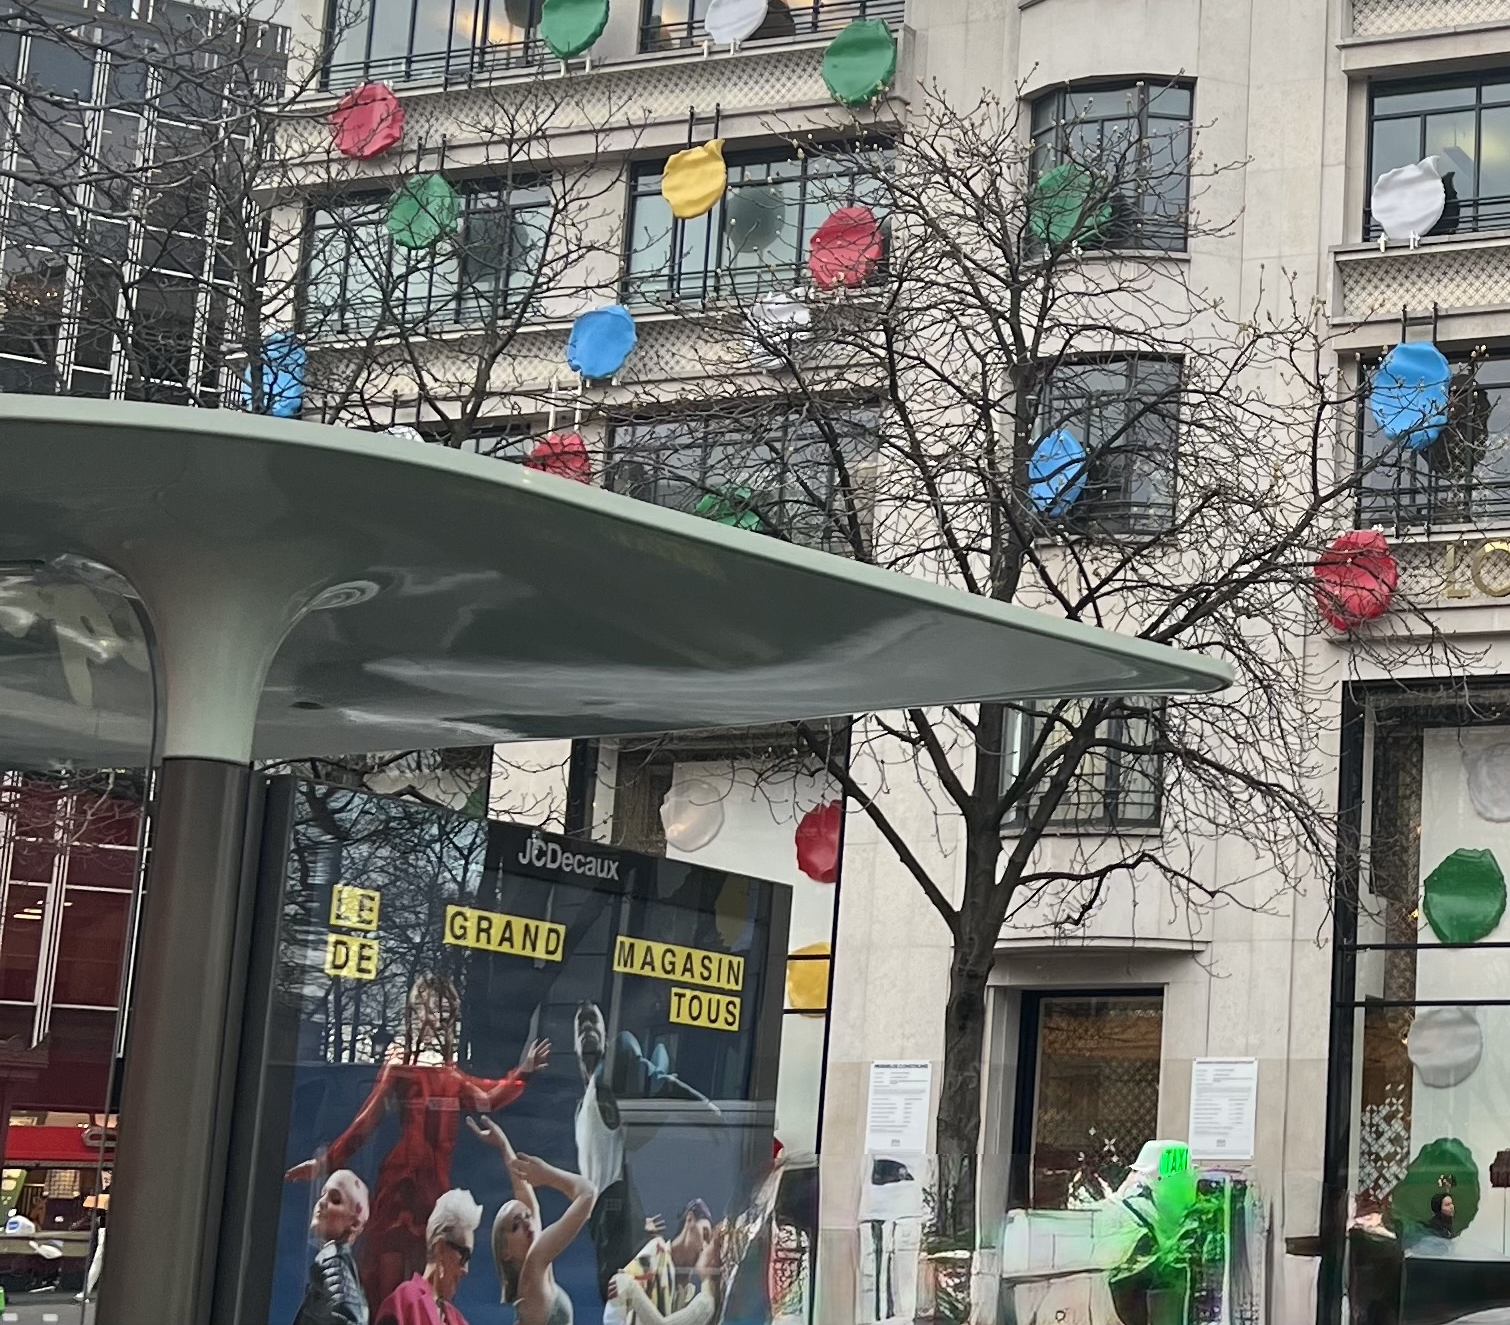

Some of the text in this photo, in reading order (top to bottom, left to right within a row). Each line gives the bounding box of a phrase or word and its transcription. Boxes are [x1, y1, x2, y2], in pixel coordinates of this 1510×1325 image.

[518, 838, 619, 881] JCDecaux
[332, 939, 374, 974] DE
[449, 910, 562, 956] GRAND
[617, 940, 742, 987] MAGASIN
[673, 991, 738, 1028] TOUS
